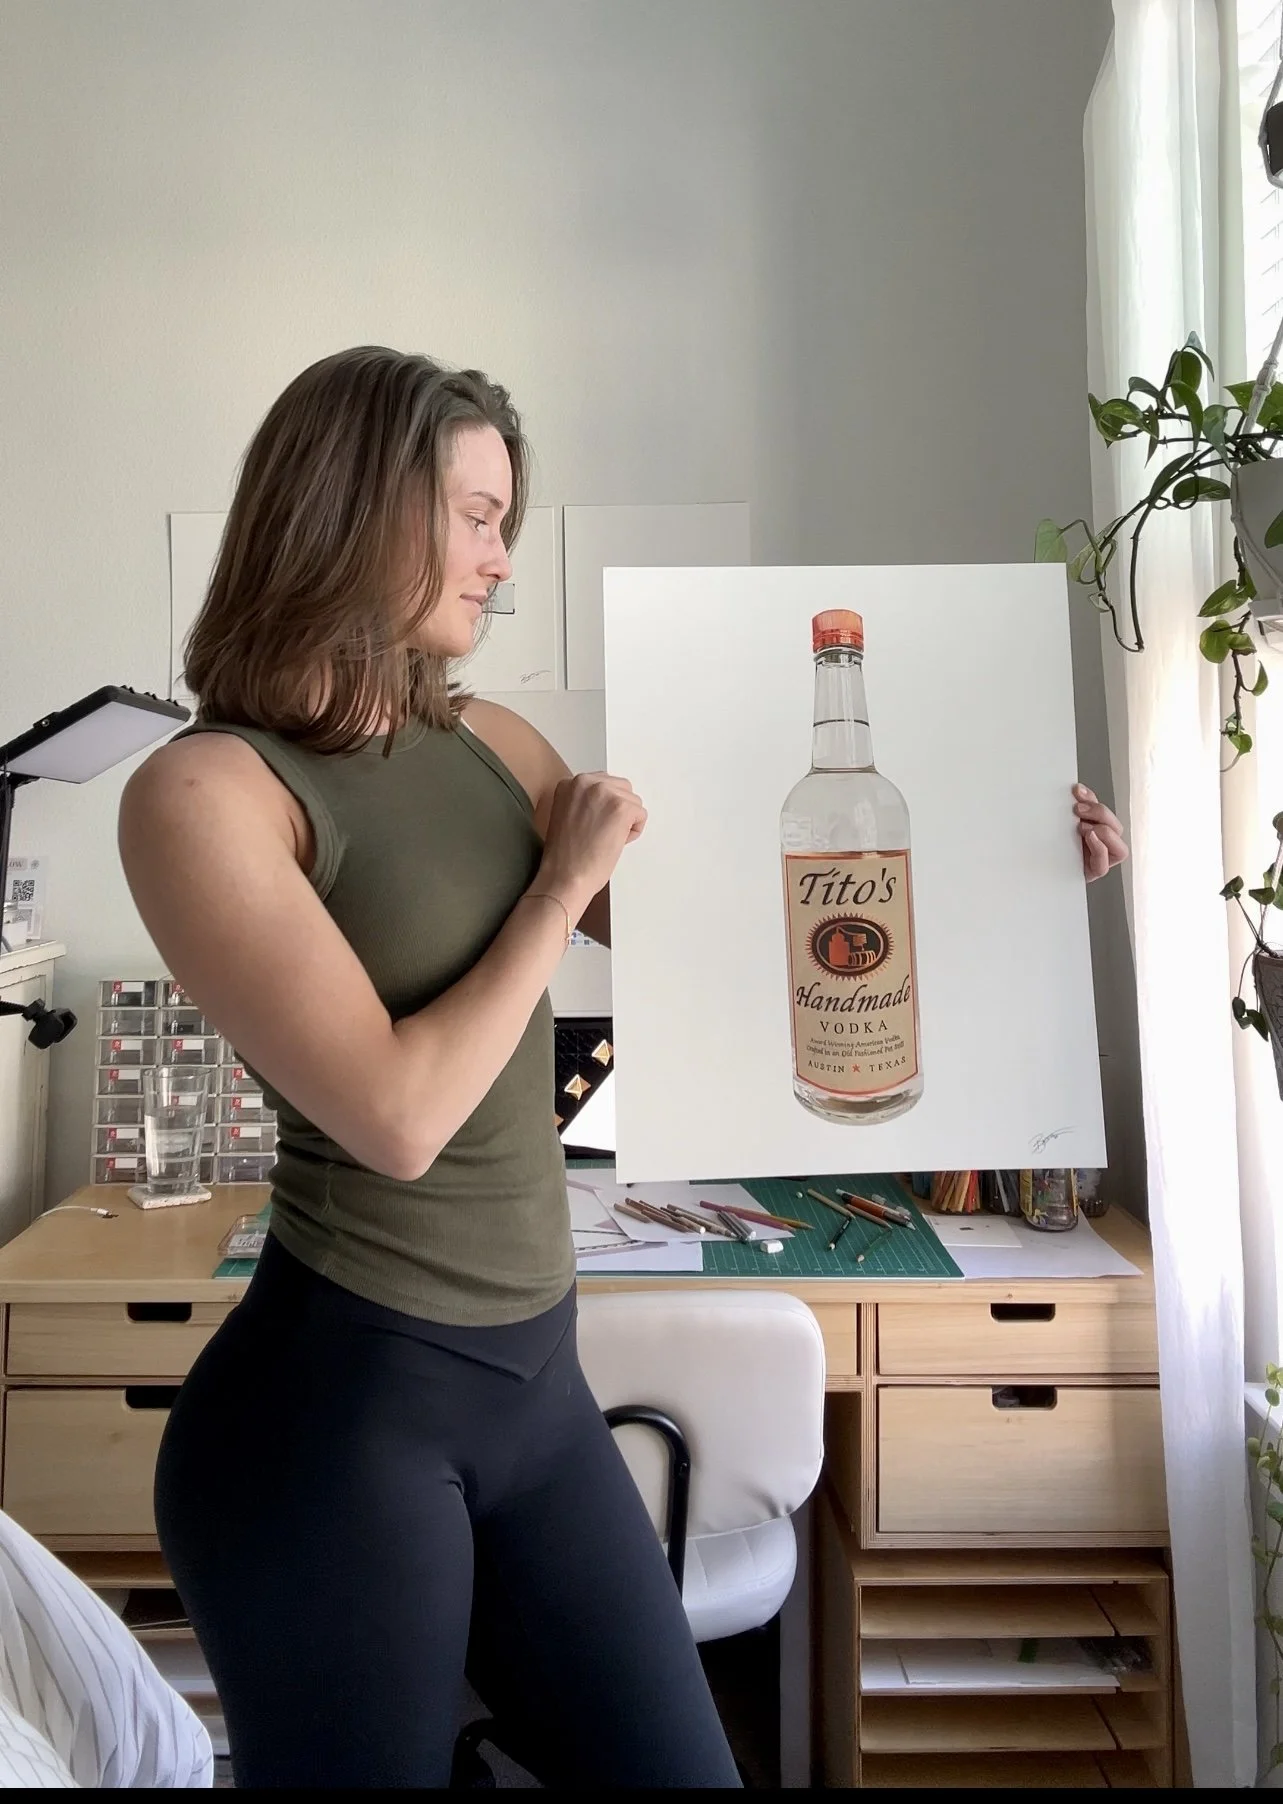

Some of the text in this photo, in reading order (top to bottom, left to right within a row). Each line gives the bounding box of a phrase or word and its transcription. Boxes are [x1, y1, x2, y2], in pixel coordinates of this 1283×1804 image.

[796, 974, 911, 1013] Handmade
[819, 1020, 888, 1034] VODKA
[808, 1056, 906, 1073] AUSTIN TEXAS
